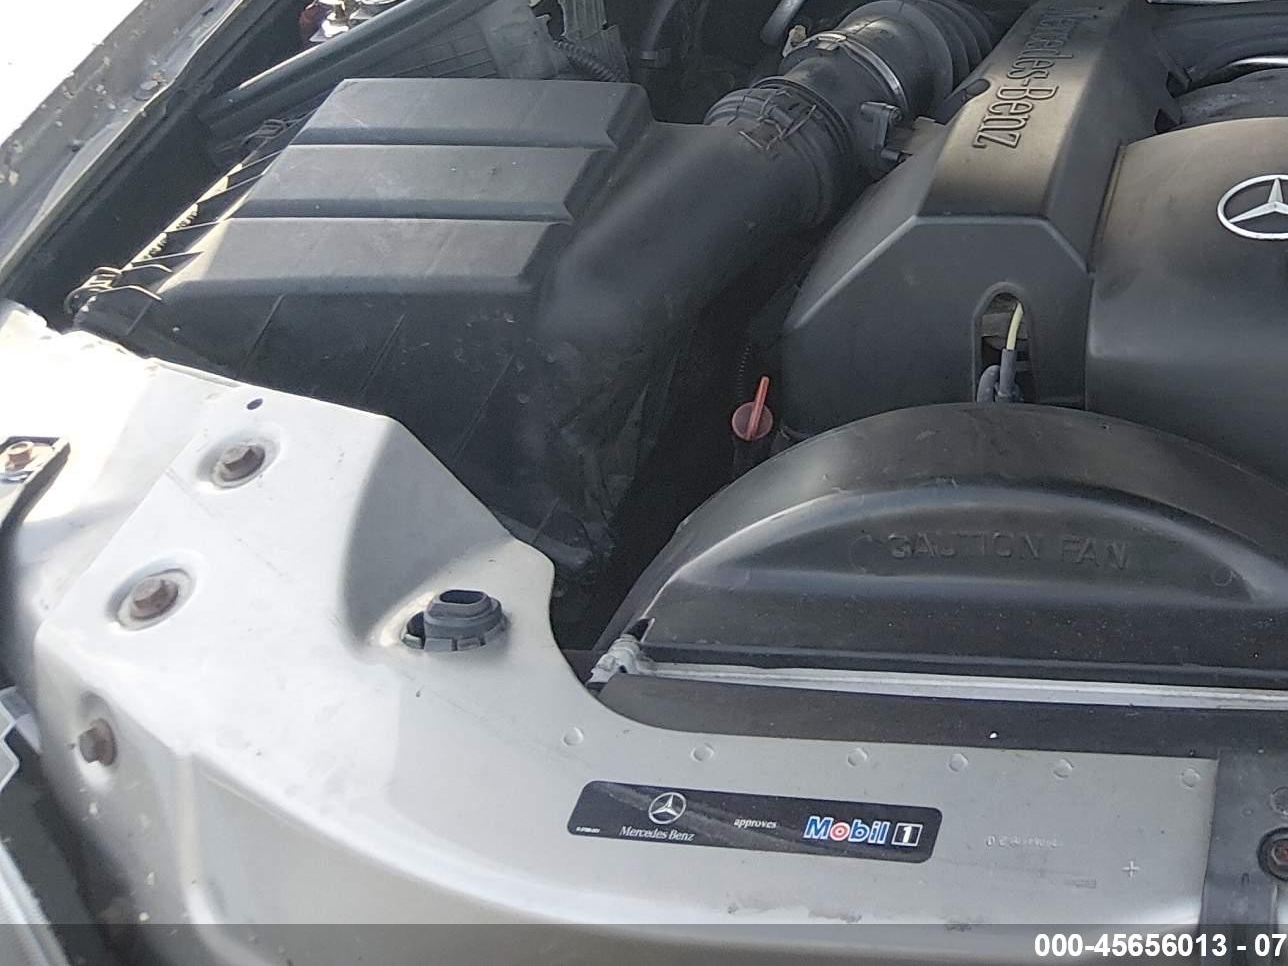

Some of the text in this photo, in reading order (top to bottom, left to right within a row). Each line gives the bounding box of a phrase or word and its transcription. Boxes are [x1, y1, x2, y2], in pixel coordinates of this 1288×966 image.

[1061, 535, 1129, 570] FAN
[619, 826, 695, 842] Mercedes Benz
[733, 818, 777, 829] approves
[803, 815, 891, 845] Mobil
